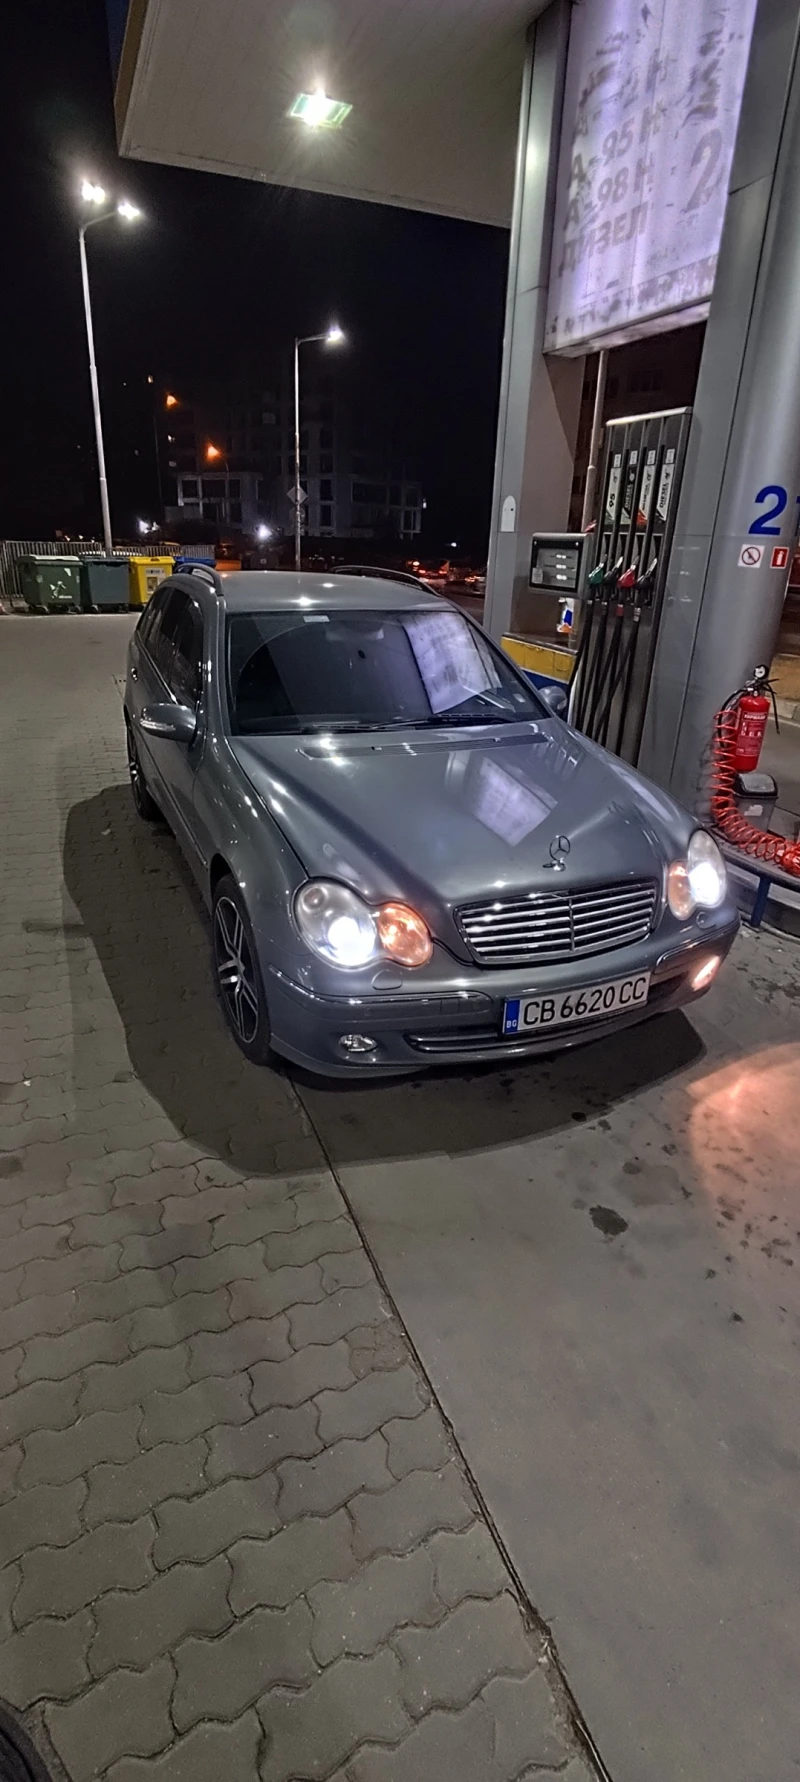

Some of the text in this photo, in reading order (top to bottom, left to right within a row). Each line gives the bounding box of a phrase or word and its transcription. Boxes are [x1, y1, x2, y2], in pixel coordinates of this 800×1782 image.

[748, 485, 788, 536] 2
[506, 1020, 518, 1028] BG
[523, 977, 647, 1026] CB 6620 CC
